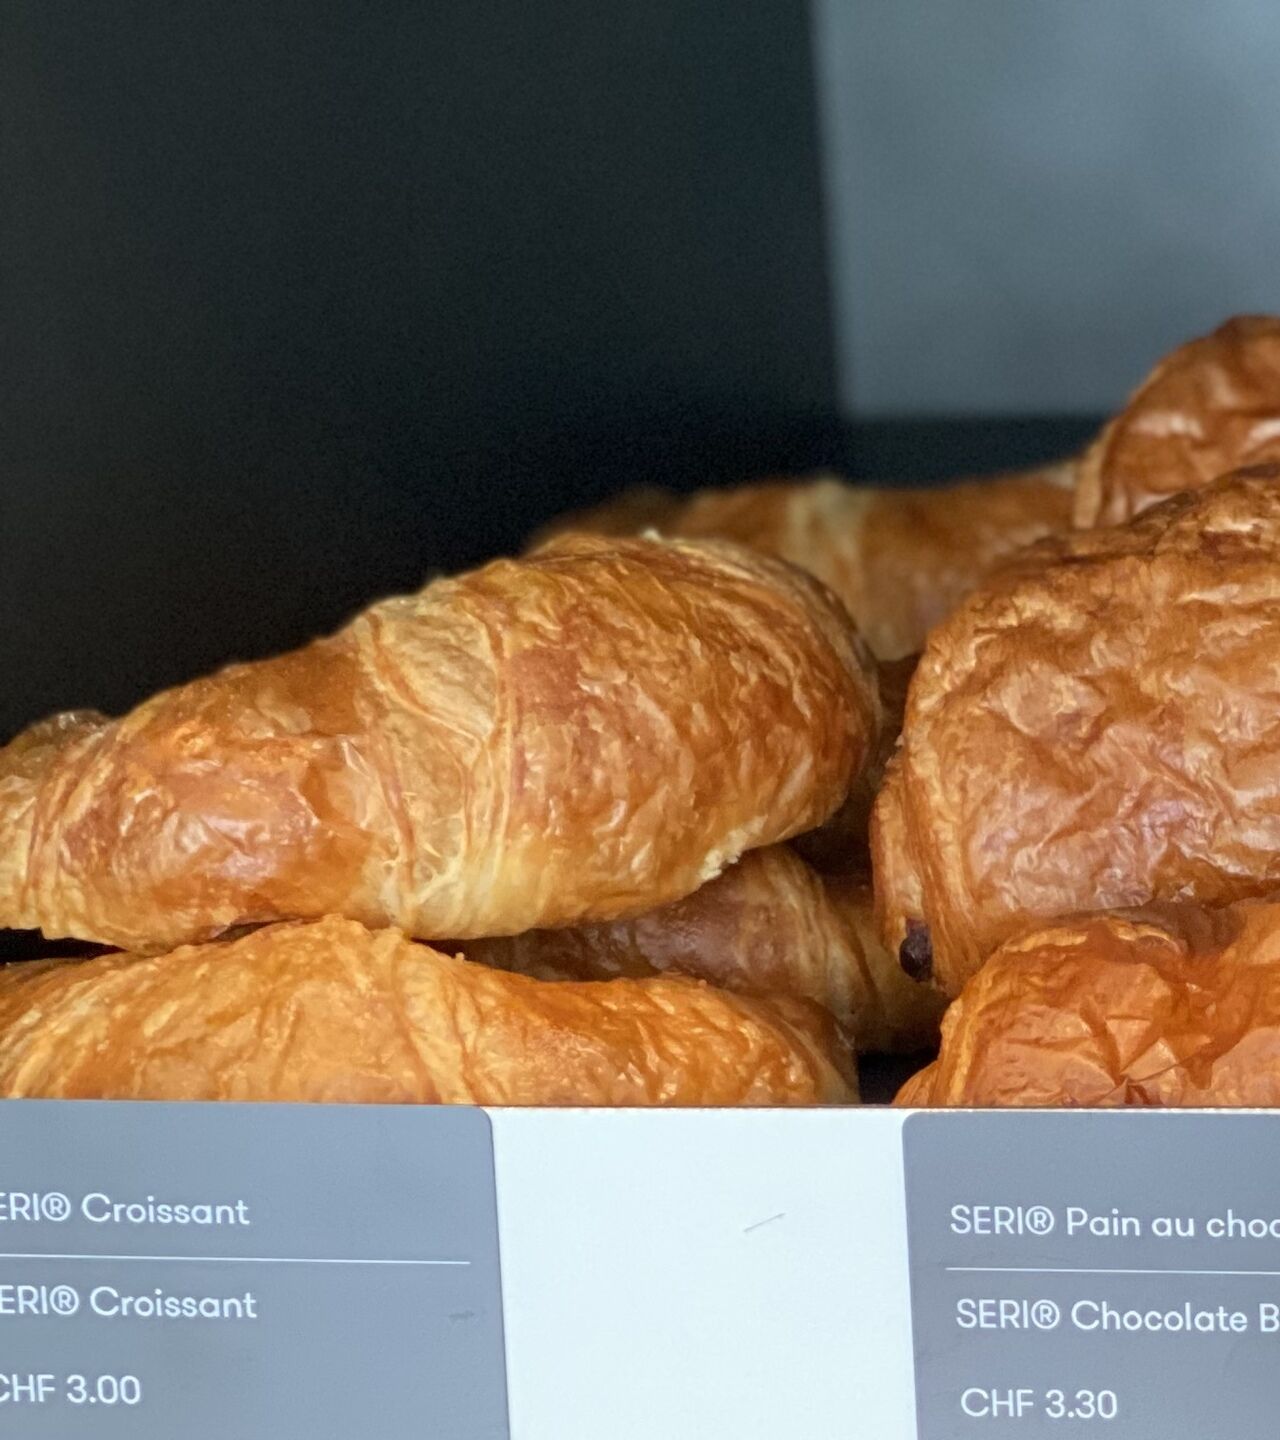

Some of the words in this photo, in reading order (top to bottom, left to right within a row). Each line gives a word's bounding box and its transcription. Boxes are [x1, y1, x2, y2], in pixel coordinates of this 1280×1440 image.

[81, 1192, 251, 1226] Croissant
[950, 1204, 1056, 1236] SERI®
[1066, 1206, 1141, 1237] Pain
[1151, 1217, 1195, 1237] au
[89, 1286, 258, 1319] Croissant
[956, 1298, 1061, 1330] SERI®
[1070, 1299, 1248, 1333] Chocolate
[66, 1374, 141, 1405] 3.00
[960, 1387, 1034, 1418] CHF
[1045, 1389, 1118, 1420] 3.30
